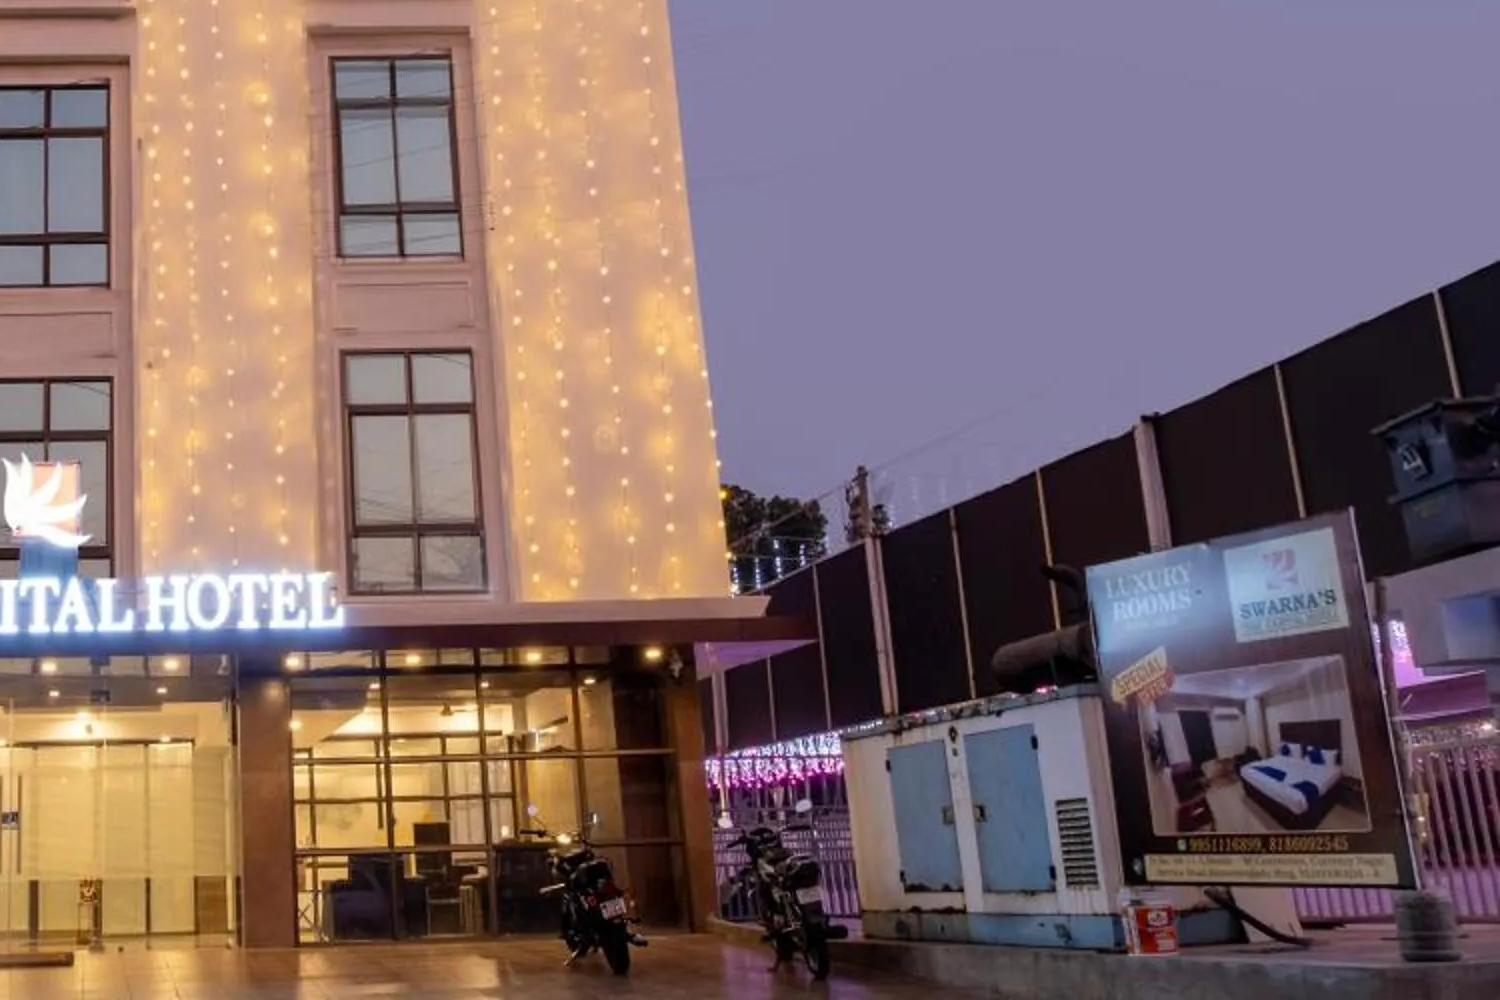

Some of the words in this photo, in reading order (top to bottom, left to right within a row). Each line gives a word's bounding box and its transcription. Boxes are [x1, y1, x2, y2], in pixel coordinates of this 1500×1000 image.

[1105, 562, 1192, 599] LUXURY
[144, 571, 345, 633] HOTEL
[1112, 588, 1192, 622] ROOMS
[1239, 588, 1338, 620] SWARNA'S
